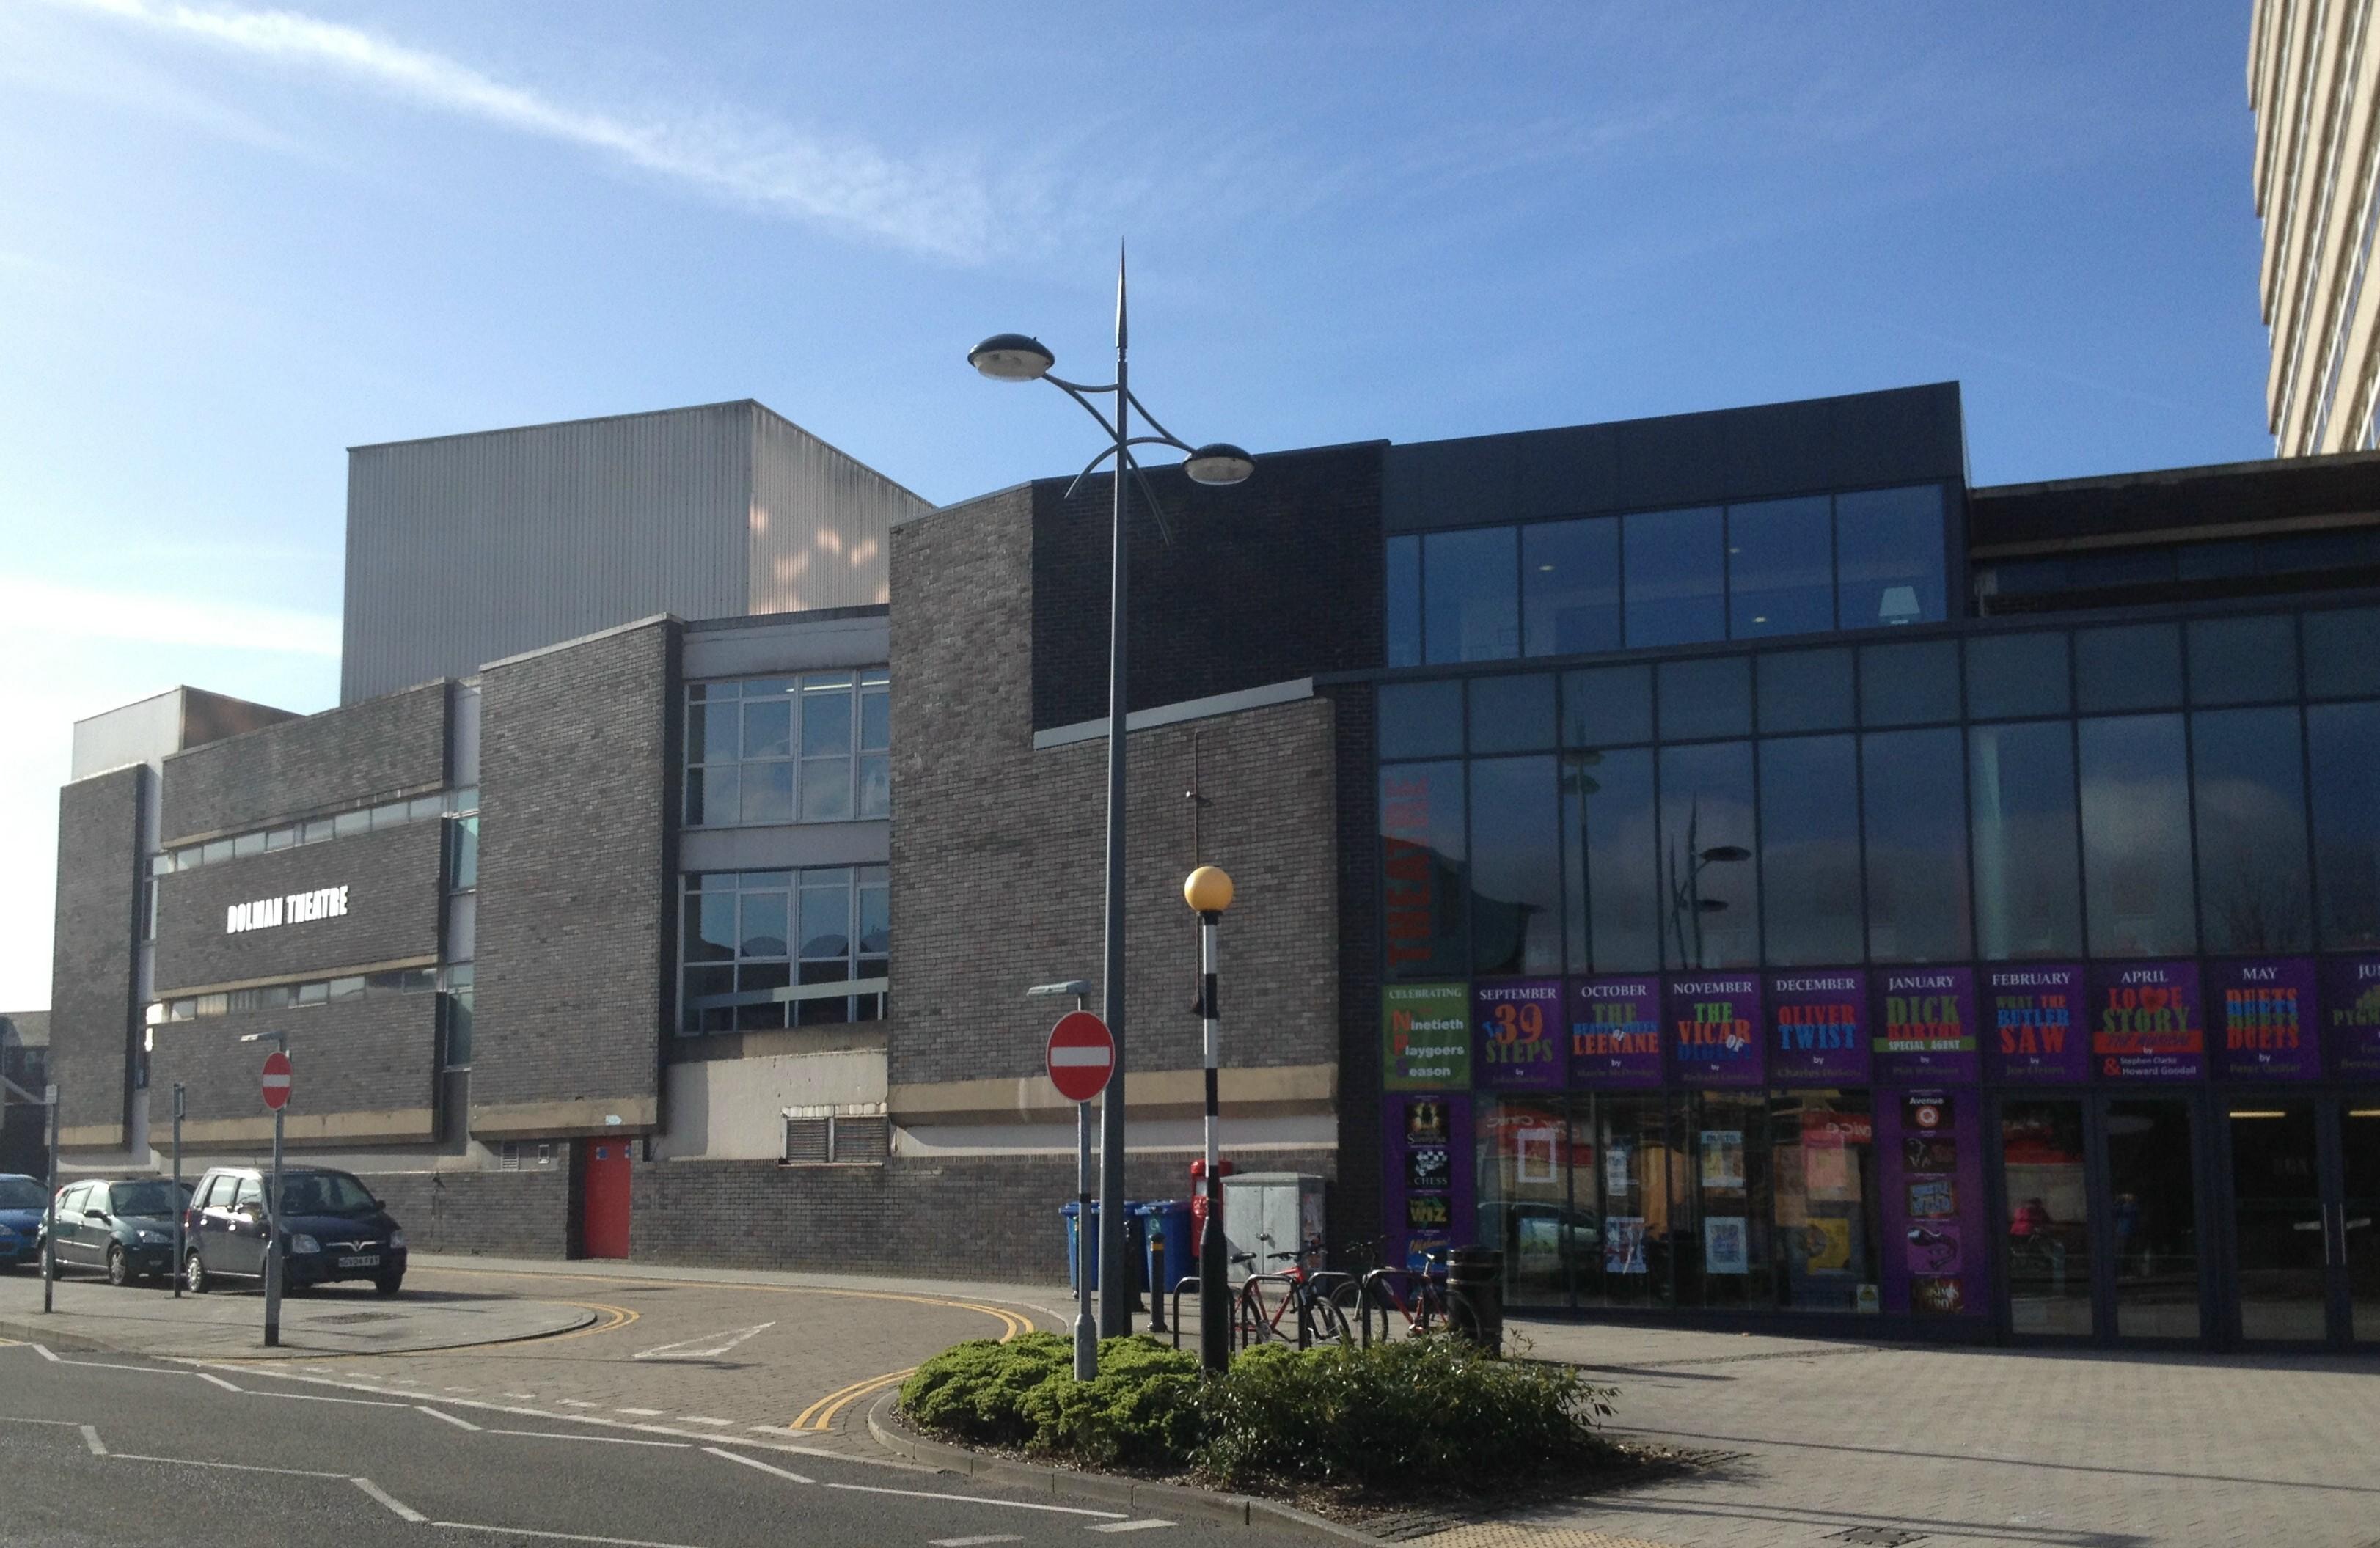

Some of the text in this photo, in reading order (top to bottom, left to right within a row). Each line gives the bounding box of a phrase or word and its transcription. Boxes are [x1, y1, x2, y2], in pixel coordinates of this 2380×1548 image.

[226, 884, 348, 934] DOLMAN THEATRE
[1992, 972, 2071, 986] FEBRUARY
[2120, 970, 2169, 983] APRIL
[2242, 966, 2277, 980] MAY
[2358, 964, 2380, 980] JU
[1674, 981, 1752, 995] NOVEMBER
[1776, 977, 1856, 991] DECEMBER
[1889, 976, 1955, 991] JANUARY
[1388, 988, 1462, 999] CELEBRATING
[1479, 988, 1557, 1001] SEPTEMBER
[1581, 985, 1647, 998] OCTOBER
[1694, 1002, 1732, 1024] THE
[1777, 1004, 1856, 1024] OLIVER
[1886, 997, 1960, 1024] DICK
[1996, 1008, 2070, 1028] BUTLER
[1391, 1009, 1464, 1032] Ninetieth
[1494, 1002, 1544, 1045] 39
[2102, 1007, 2191, 1032] STORY
[1677, 1019, 1751, 1045] VICAR
[1777, 1023, 1856, 1050] TWIST
[1999, 1024, 2066, 1054] SAW
[2226, 1024, 2301, 1051] DUETS
[1394, 1033, 1465, 1058] Playgoers
[1572, 1032, 1660, 1056] LEENANE
[1725, 1034, 1745, 1052] OF
[1889, 1039, 1960, 1052] SPECIAL AGENT
[1485, 1038, 1553, 1064] STEPS
[2258, 1052, 2271, 1063] by
[1611, 1059, 1622, 1068] by
[1813, 1057, 1824, 1065] by
[2030, 1057, 2040, 1065] by
[2123, 1065, 2197, 1076] Howard Goodall
[1908, 1096, 1944, 1106] Avenue
[1413, 1177, 1449, 1186] CHESS
[1410, 1207, 1447, 1222] WIZ
